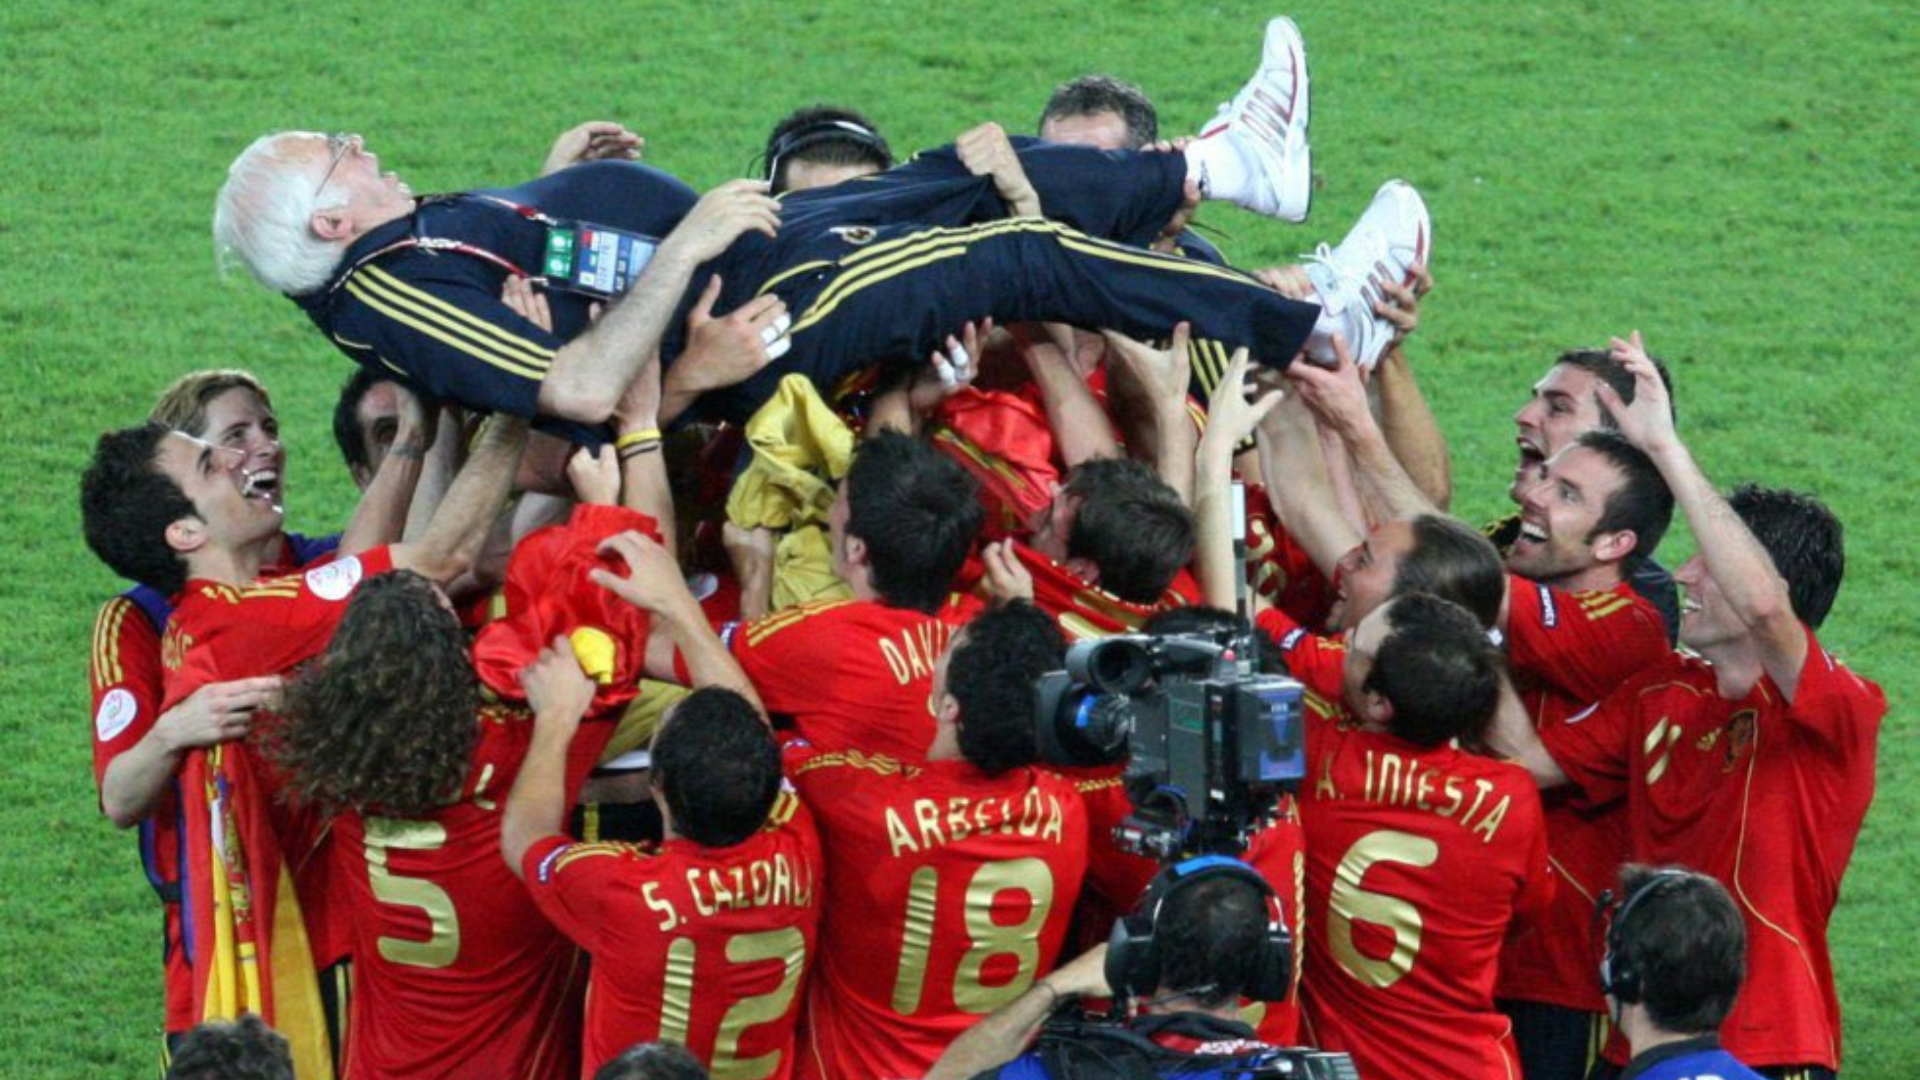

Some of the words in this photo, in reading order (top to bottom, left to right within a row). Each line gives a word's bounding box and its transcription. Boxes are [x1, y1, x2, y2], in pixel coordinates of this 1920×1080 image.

[884, 786, 1063, 858] ARBELOA
[1364, 750, 1511, 843] INIESTA
[363, 816, 460, 969] 5
[641, 880, 688, 932] S.
[892, 857, 1053, 1015] 18
[1327, 830, 1440, 988] 6
[656, 927, 806, 1080] 12
